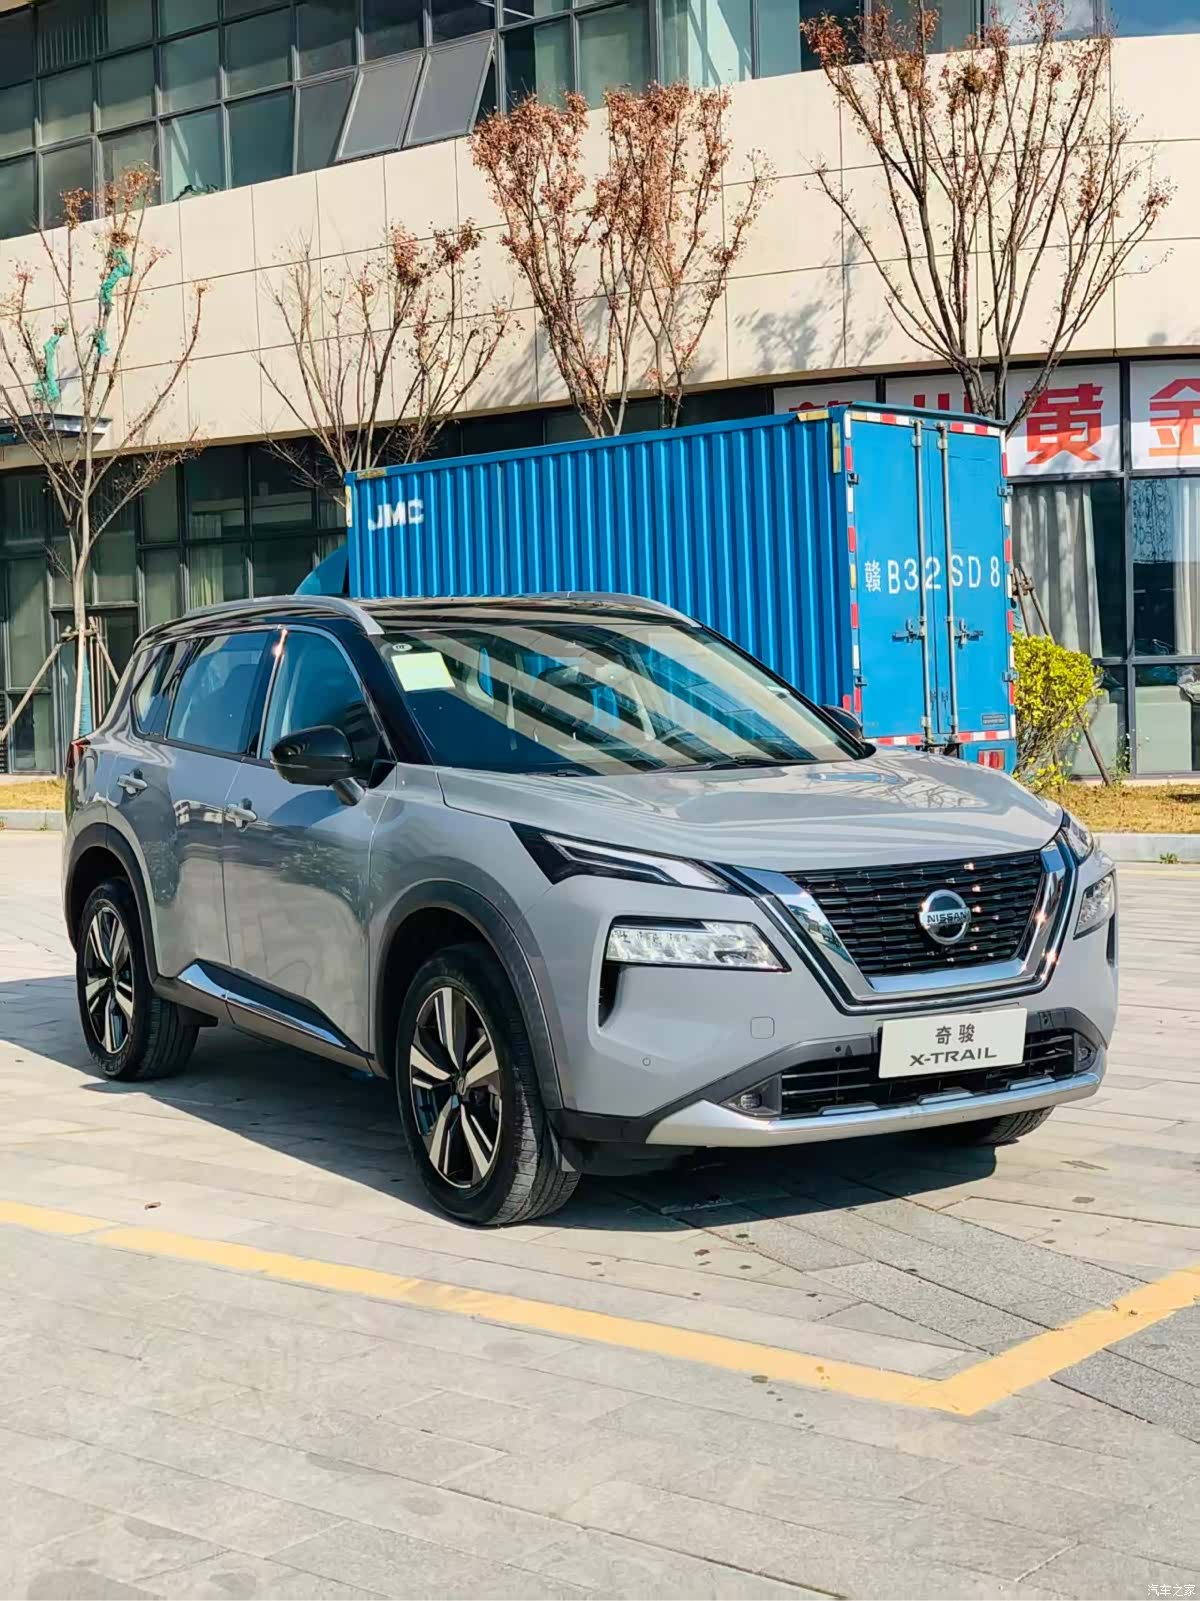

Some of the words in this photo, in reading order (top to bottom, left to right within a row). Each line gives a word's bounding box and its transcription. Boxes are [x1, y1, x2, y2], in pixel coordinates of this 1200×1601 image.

[367, 498, 425, 532] JMC
[927, 911, 967, 924] NISSAN
[935, 1023, 976, 1045] 奇骏
[909, 1047, 998, 1067] X-TRAIL
